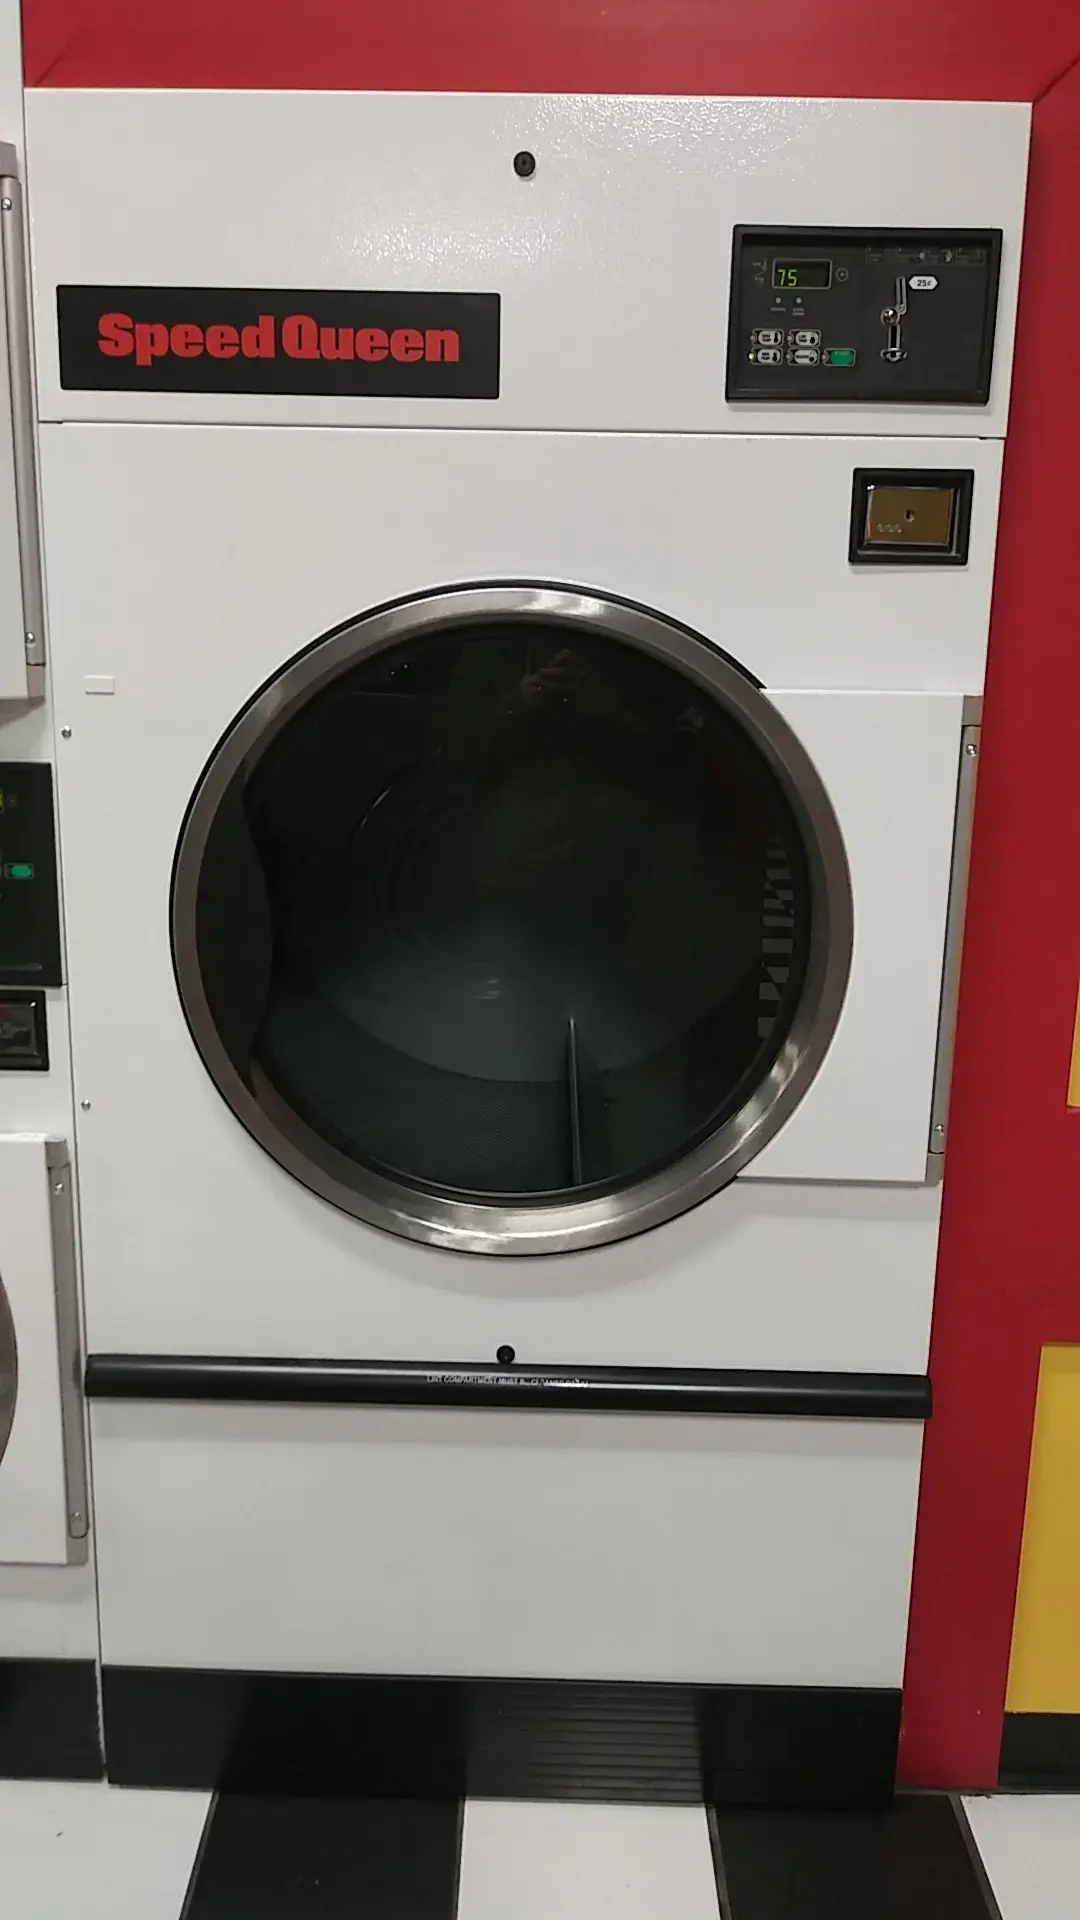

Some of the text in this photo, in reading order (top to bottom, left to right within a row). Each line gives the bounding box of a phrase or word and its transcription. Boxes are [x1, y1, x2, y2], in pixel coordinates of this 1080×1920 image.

[777, 268, 798, 287] 75
[98, 312, 460, 366] Speed Queen
